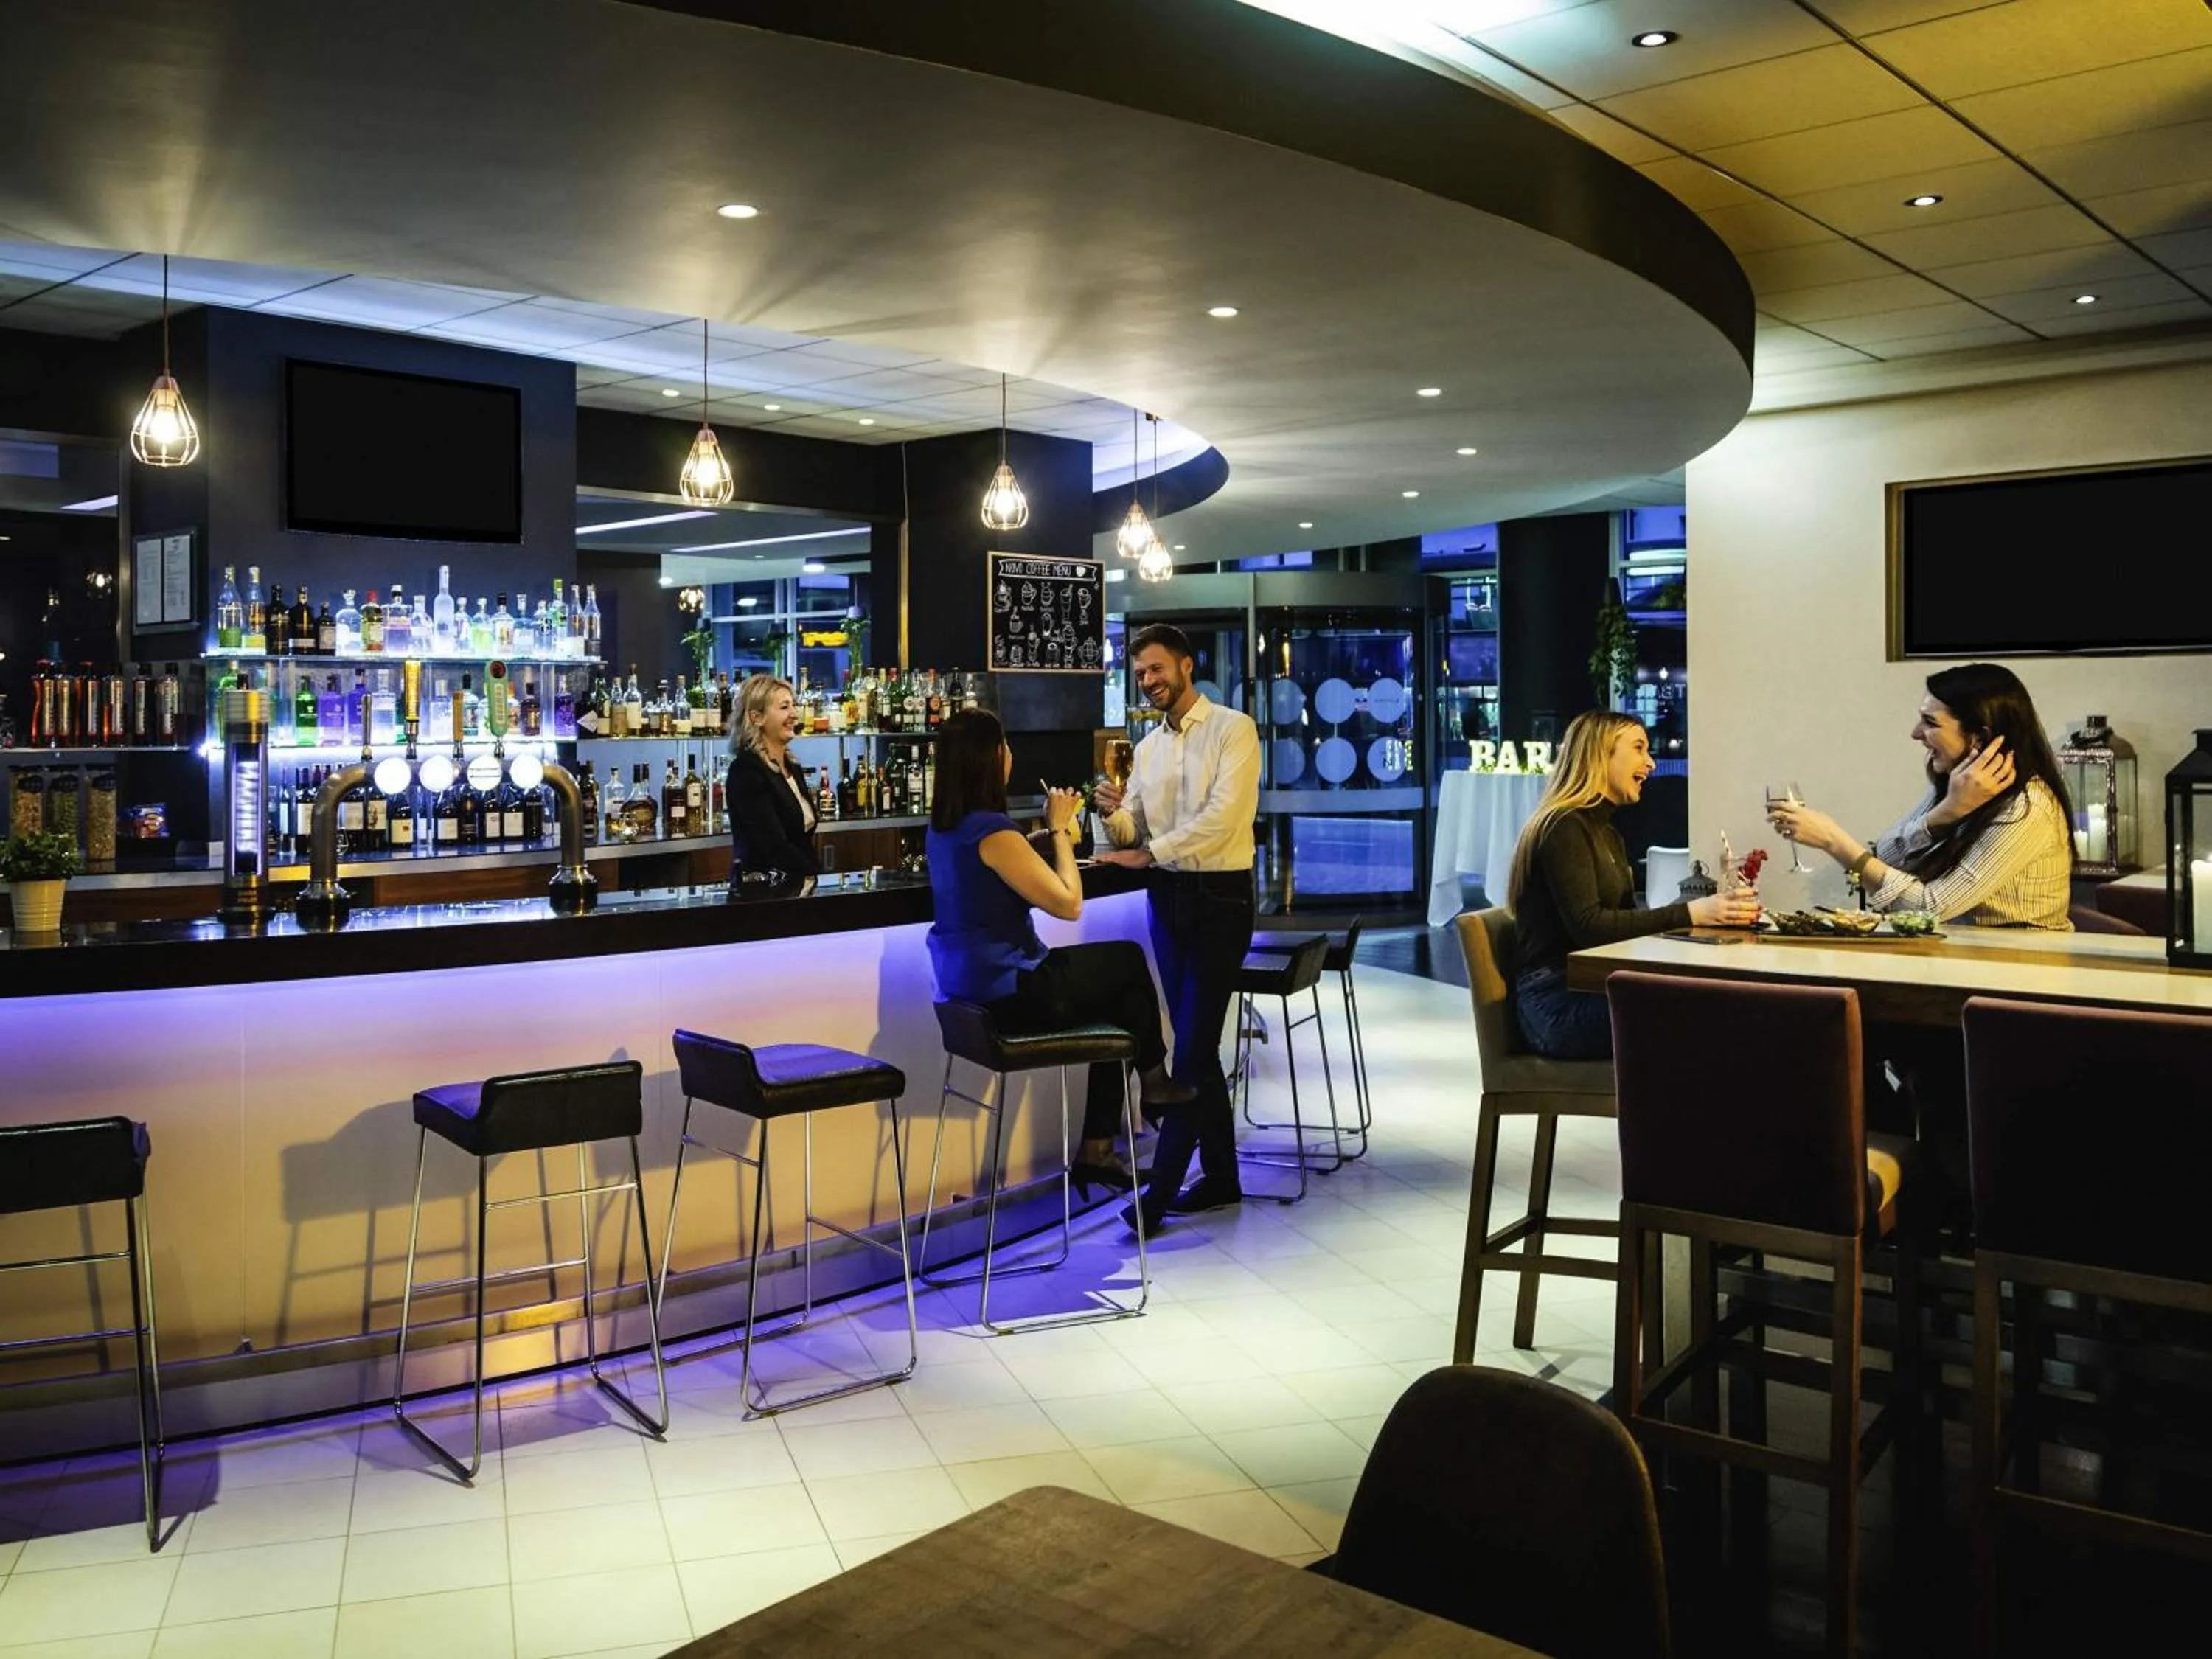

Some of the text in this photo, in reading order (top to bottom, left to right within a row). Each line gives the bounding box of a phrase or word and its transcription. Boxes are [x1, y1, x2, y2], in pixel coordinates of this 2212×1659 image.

[1026, 563, 1051, 576] COFFEE
[1053, 565, 1071, 577] MENU
[1469, 739, 1555, 774] BAR
